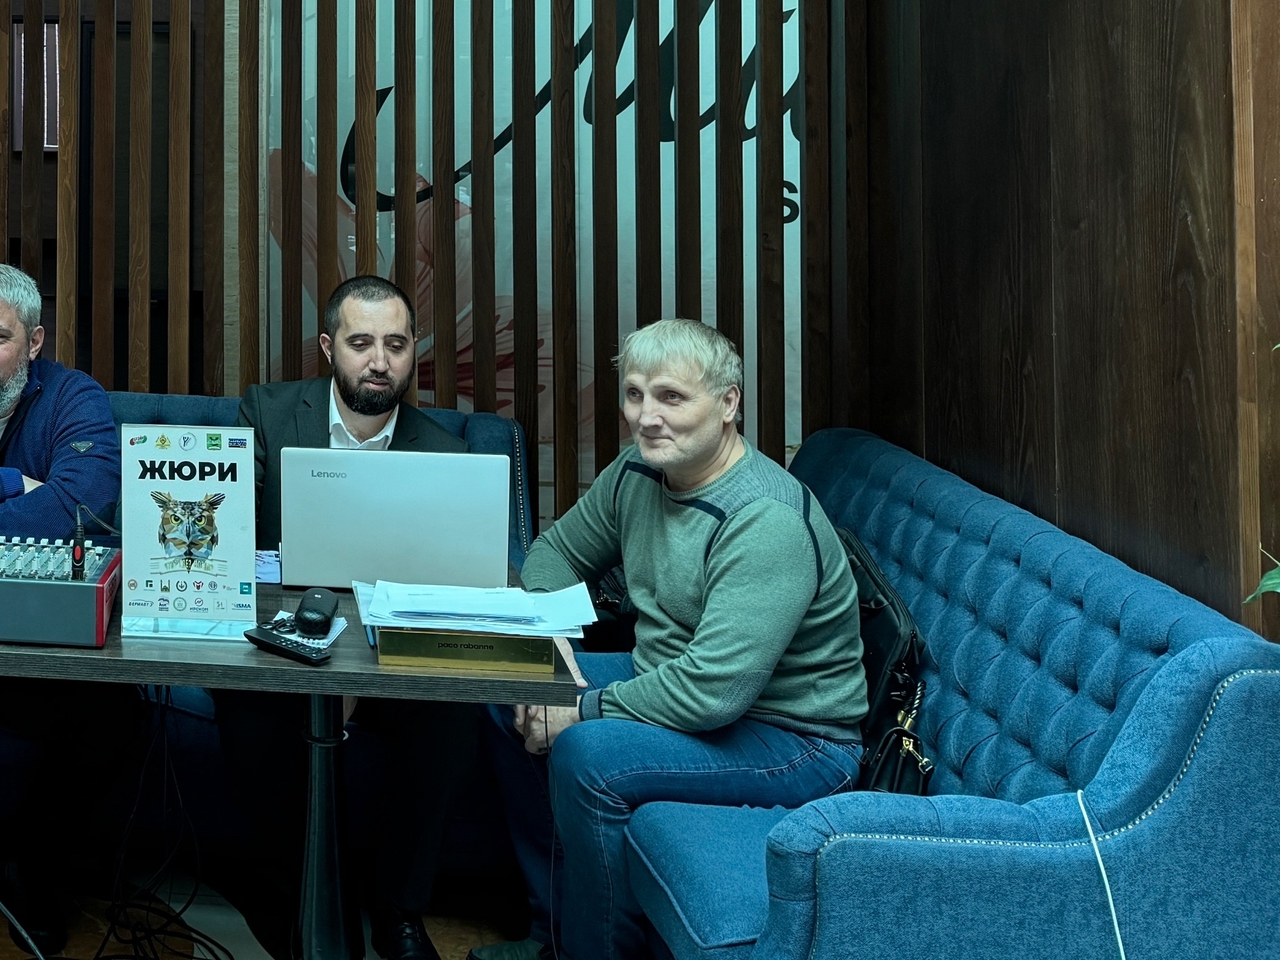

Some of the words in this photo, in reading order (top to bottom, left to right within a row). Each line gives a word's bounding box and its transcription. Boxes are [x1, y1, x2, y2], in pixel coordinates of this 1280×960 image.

[137, 459, 238, 482] ЖЮРИ
[311, 469, 347, 479] Lenovo
[460, 643, 495, 651] rabanne
